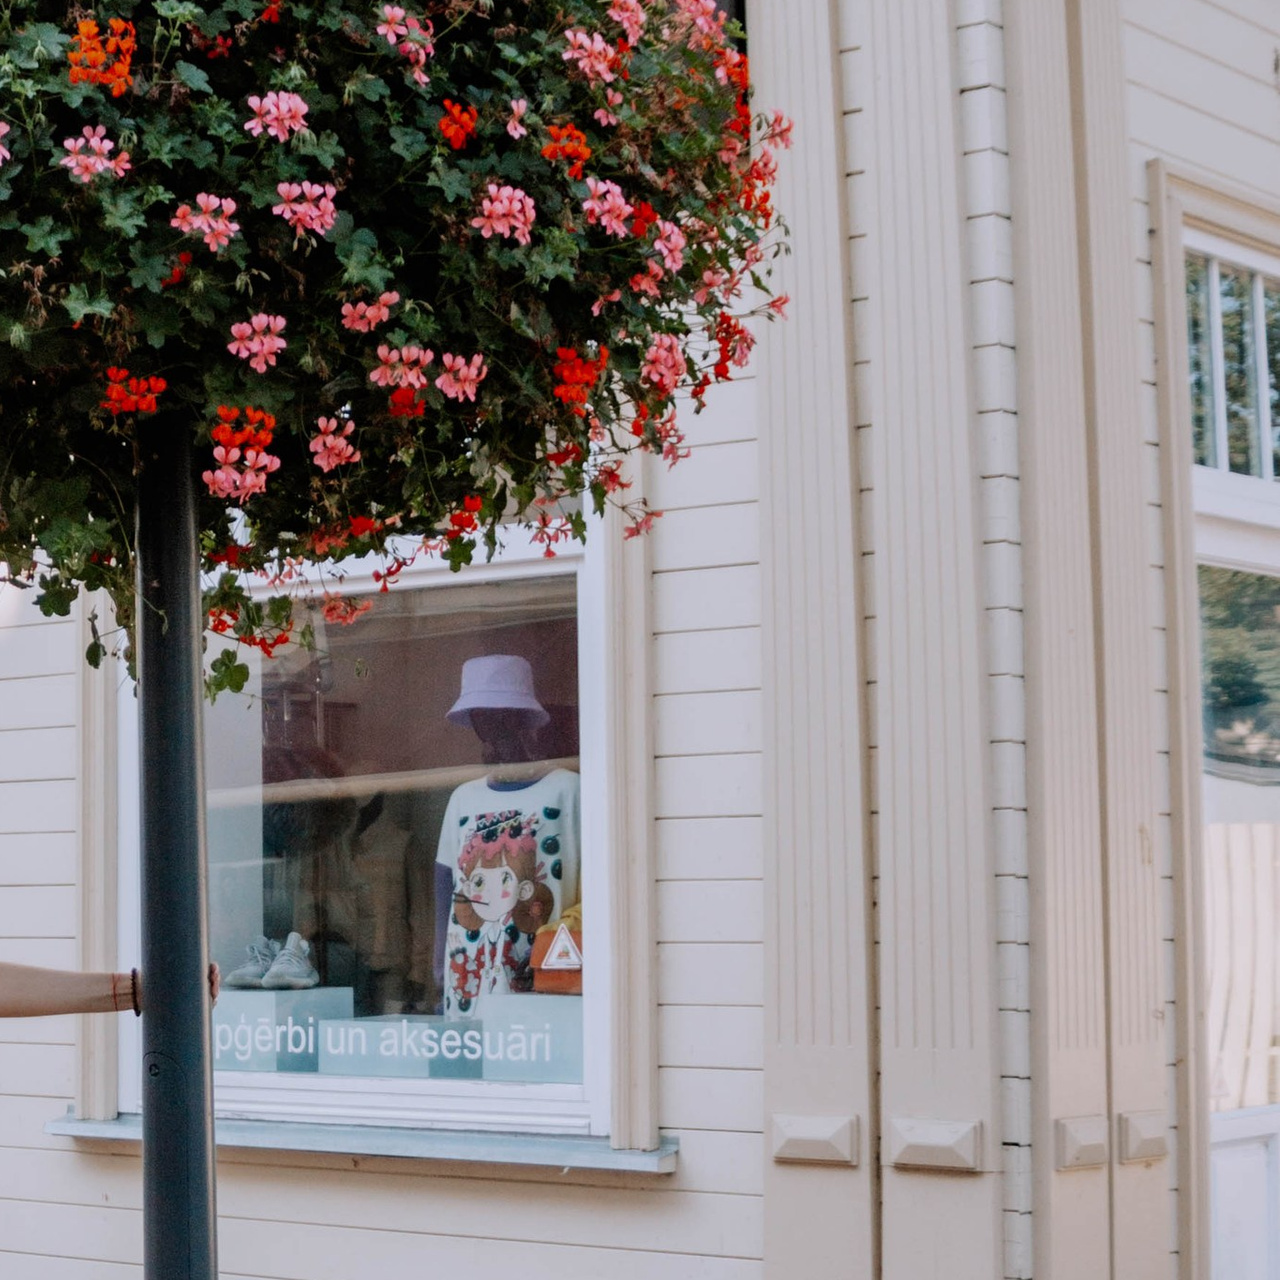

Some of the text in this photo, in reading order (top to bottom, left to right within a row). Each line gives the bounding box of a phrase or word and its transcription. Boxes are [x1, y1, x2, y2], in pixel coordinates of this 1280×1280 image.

[215, 1013, 551, 1062] pģērbi un aksesuāri
